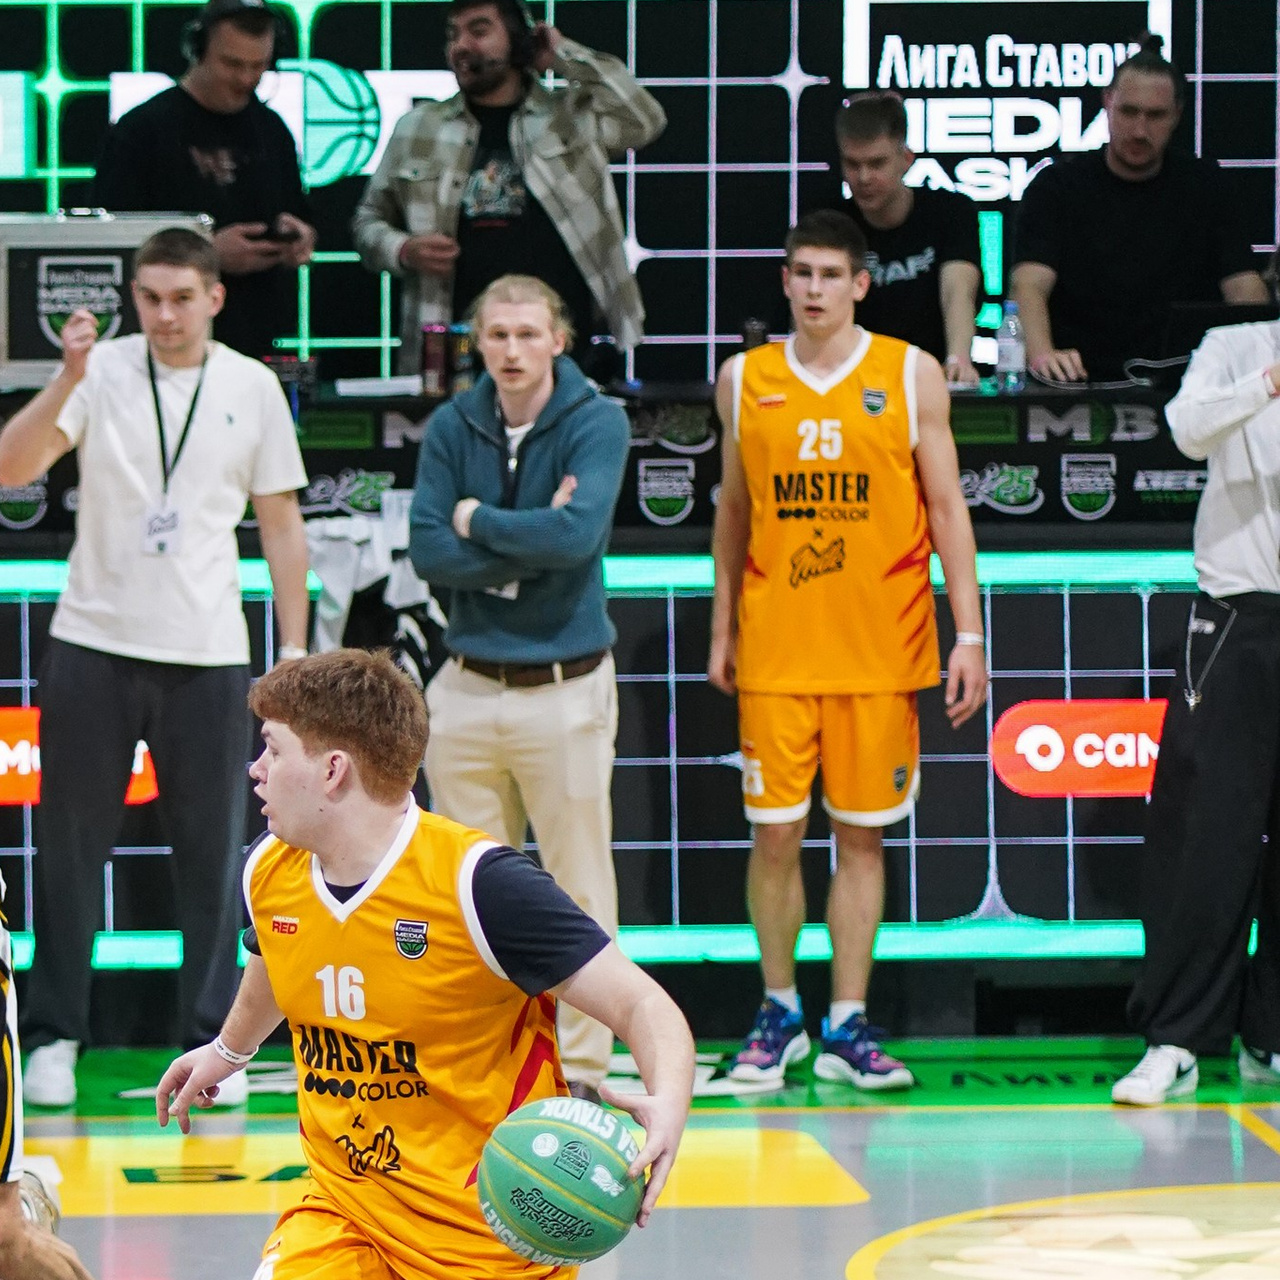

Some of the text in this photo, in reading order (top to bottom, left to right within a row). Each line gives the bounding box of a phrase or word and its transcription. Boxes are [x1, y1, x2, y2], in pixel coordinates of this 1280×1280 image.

[797, 418, 844, 461] 25
[773, 472, 870, 503] MASTER
[271, 920, 298, 935] RED
[315, 964, 367, 1021] 16
[357, 1079, 430, 1102] COLOR
